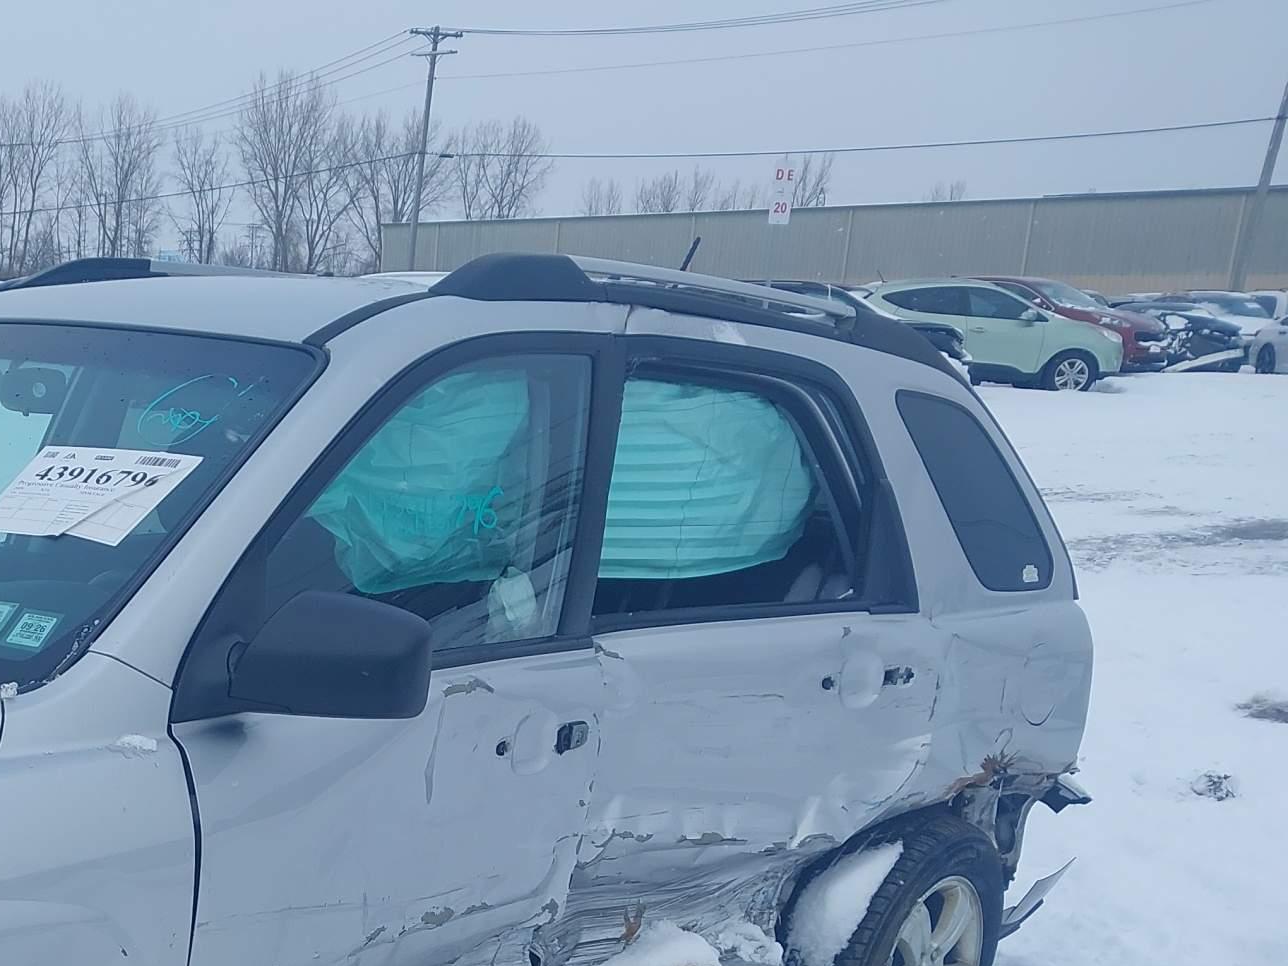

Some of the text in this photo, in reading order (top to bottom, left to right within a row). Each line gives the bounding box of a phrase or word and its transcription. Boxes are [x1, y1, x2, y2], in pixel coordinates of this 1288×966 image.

[776, 168, 794, 181] D E
[774, 202, 787, 214] 20
[35, 465, 164, 488] 43916796
[34, 624, 46, 632] 26
